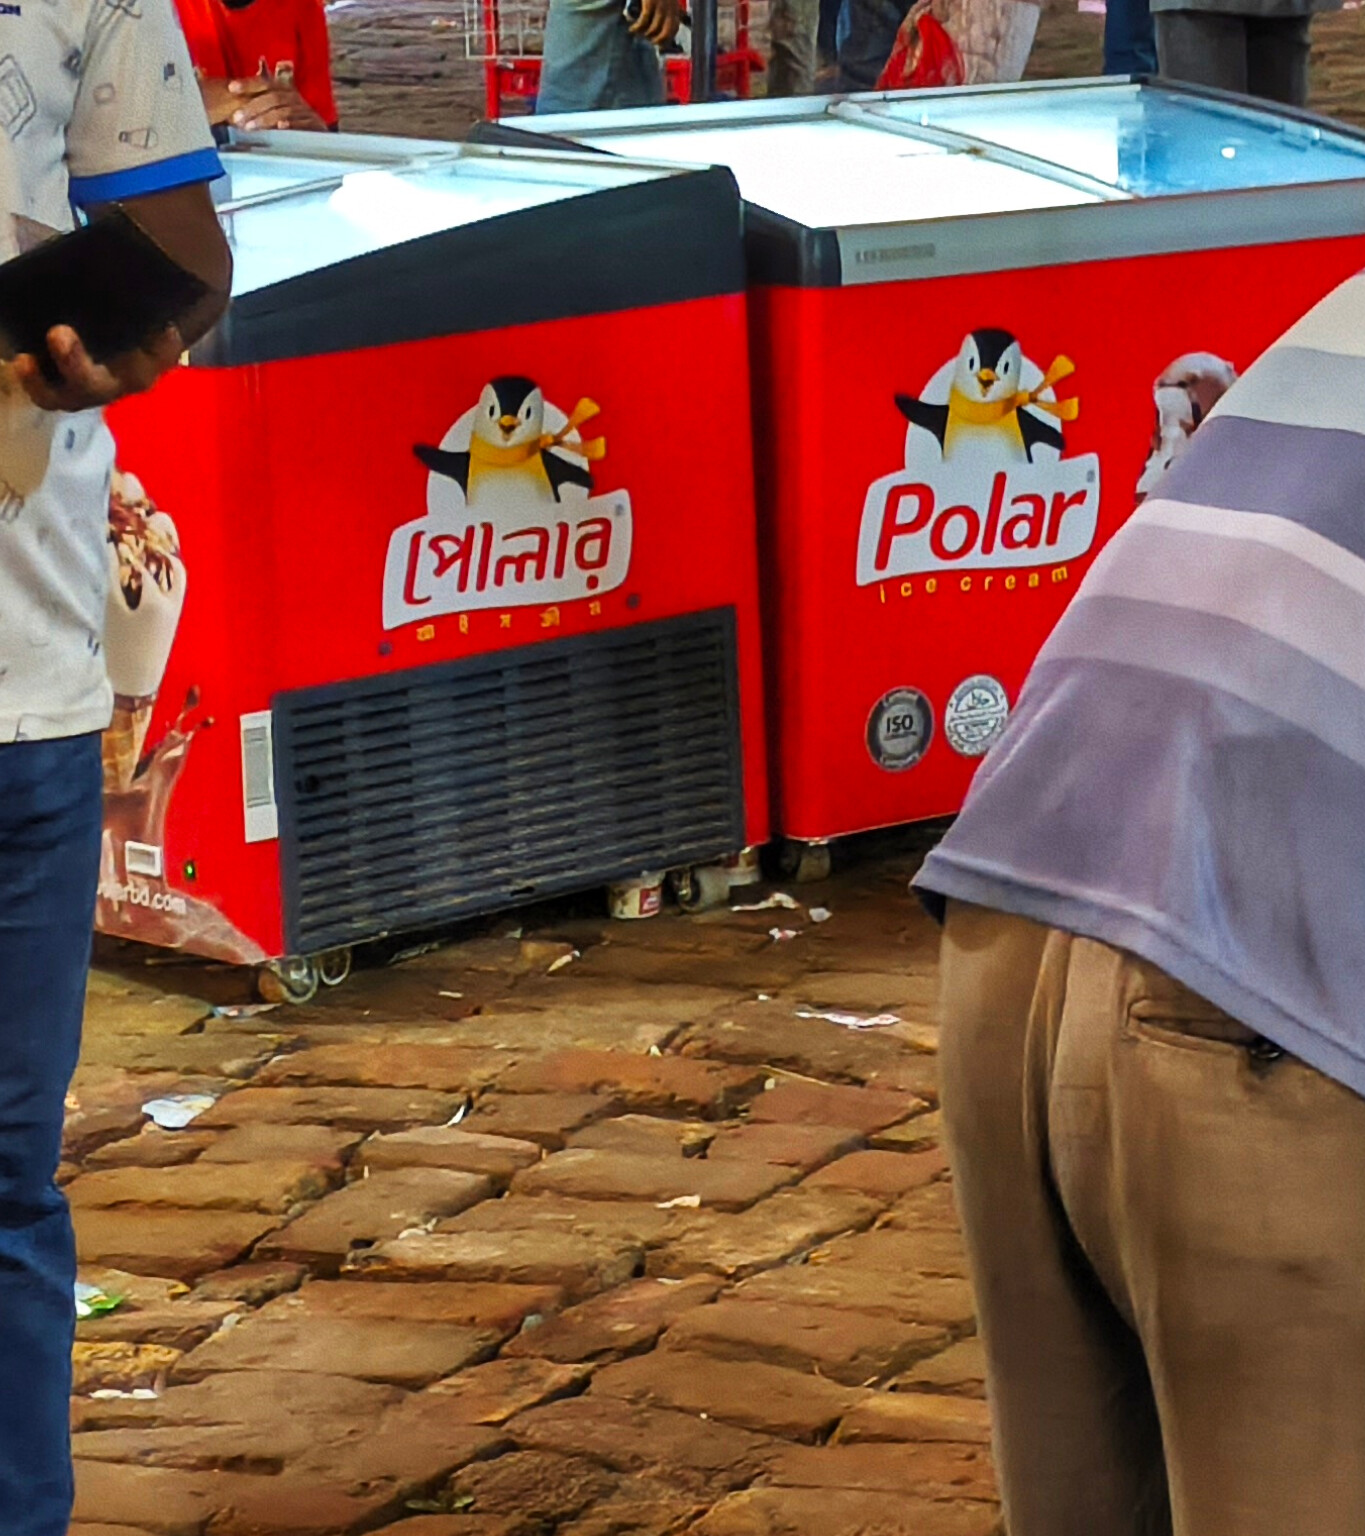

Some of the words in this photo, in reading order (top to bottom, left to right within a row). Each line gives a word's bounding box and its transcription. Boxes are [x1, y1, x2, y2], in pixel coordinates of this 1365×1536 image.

[402, 515, 614, 606] পোলার
[873, 470, 1089, 573] Polar
[886, 713, 915, 734] ISO
